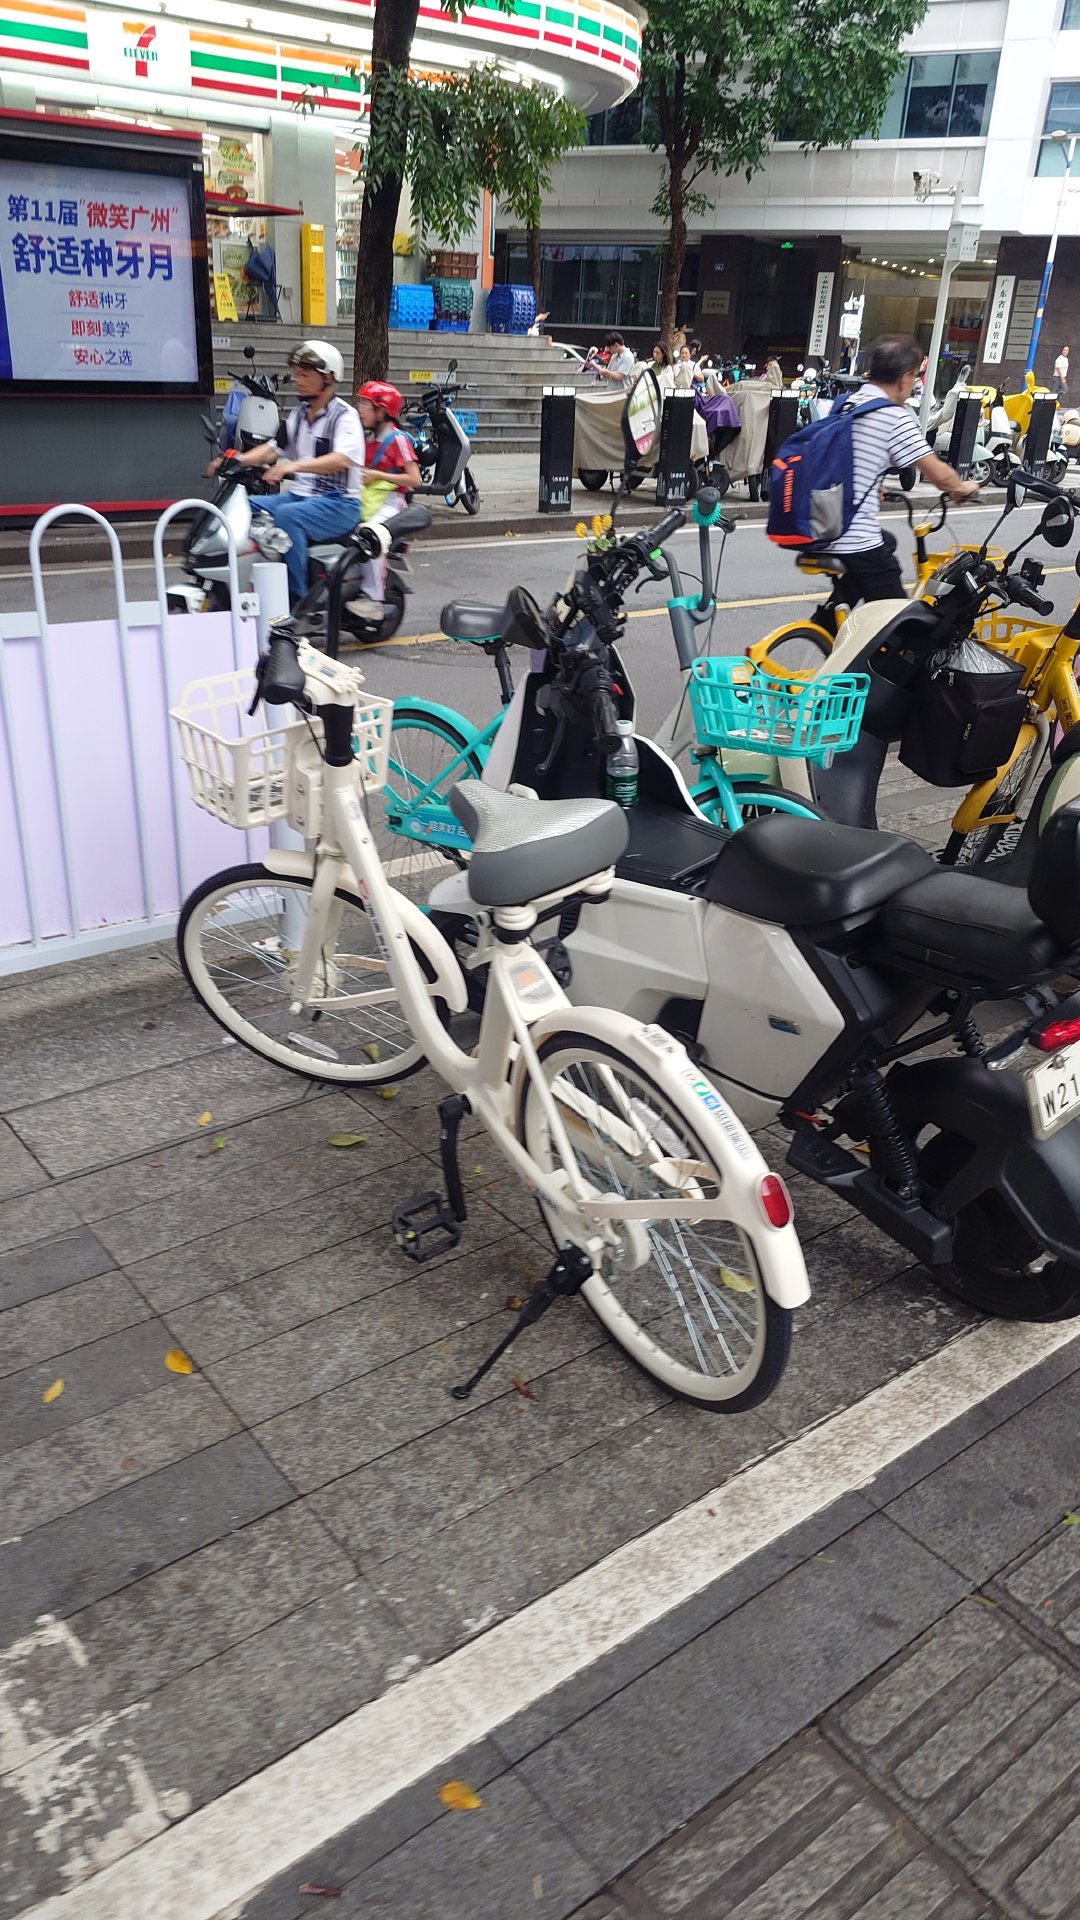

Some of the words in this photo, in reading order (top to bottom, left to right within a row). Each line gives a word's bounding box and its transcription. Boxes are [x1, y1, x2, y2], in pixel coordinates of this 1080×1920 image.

[122, 22, 157, 78] 7
[11, 232, 174, 282] 舒适种牙月
[68, 289, 128, 310] 舒适种牙
[71, 319, 130, 338] 即刻美学
[73, 348, 133, 366] 安心之选
[1042, 1073, 1080, 1119] W21
